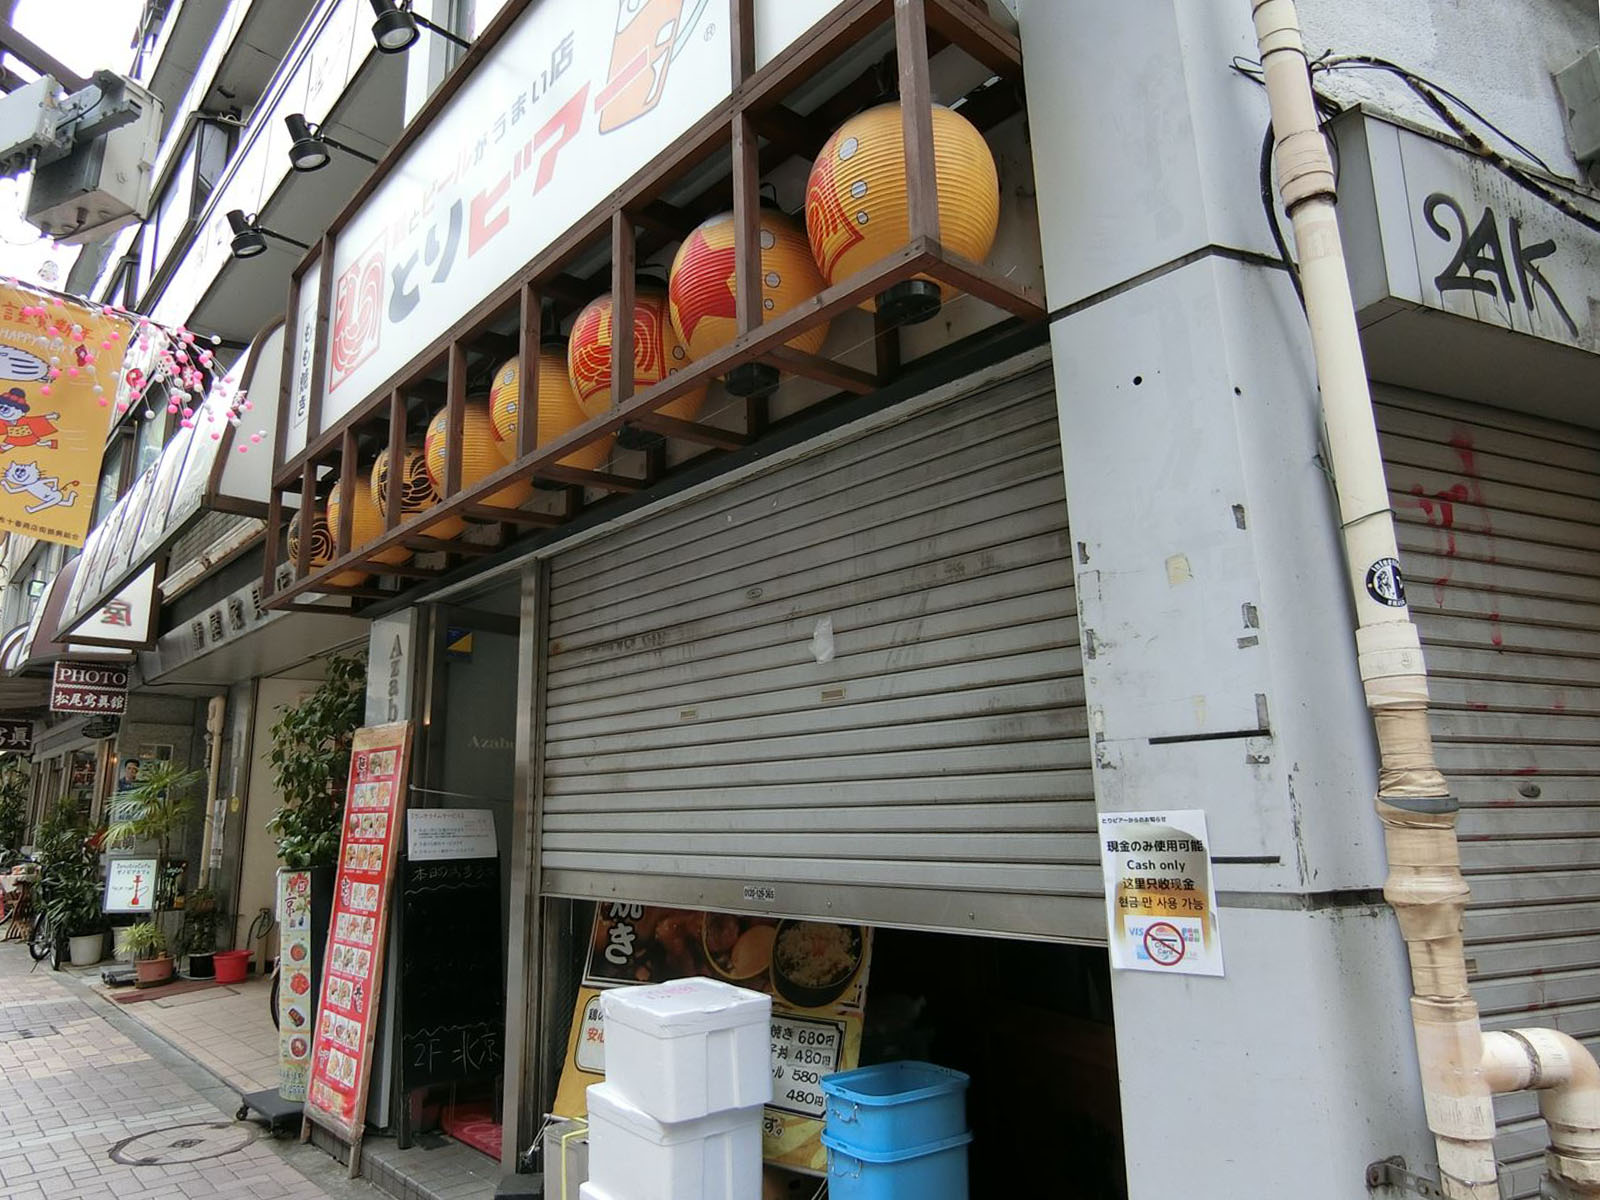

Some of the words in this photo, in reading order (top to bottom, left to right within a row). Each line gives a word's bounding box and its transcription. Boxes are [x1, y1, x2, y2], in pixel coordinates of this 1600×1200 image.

[391, 29, 576, 250] とビールがうまい店
[58, 667, 127, 685] PHOTO
[1107, 839, 1204, 853] 現金のみ使用可能
[1126, 859, 1156, 870] Cash
[1159, 859, 1186, 872] only
[1123, 877, 1195, 891] 这里只收现金
[1118, 896, 1139, 908] 현금
[1142, 897, 1153, 909] 만
[1156, 897, 1178, 910] 사용
[1182, 897, 1204, 911] 가능
[1129, 927, 1144, 936] VIS
[798, 1029, 835, 1047] 680円
[413, 1038, 443, 1073] 2F
[452, 1029, 502, 1073] 北京
[794, 1048, 831, 1067] 480円
[772, 1065, 785, 1079] ル
[791, 1068, 821, 1085] 580
[786, 1088, 824, 1107] 480円
